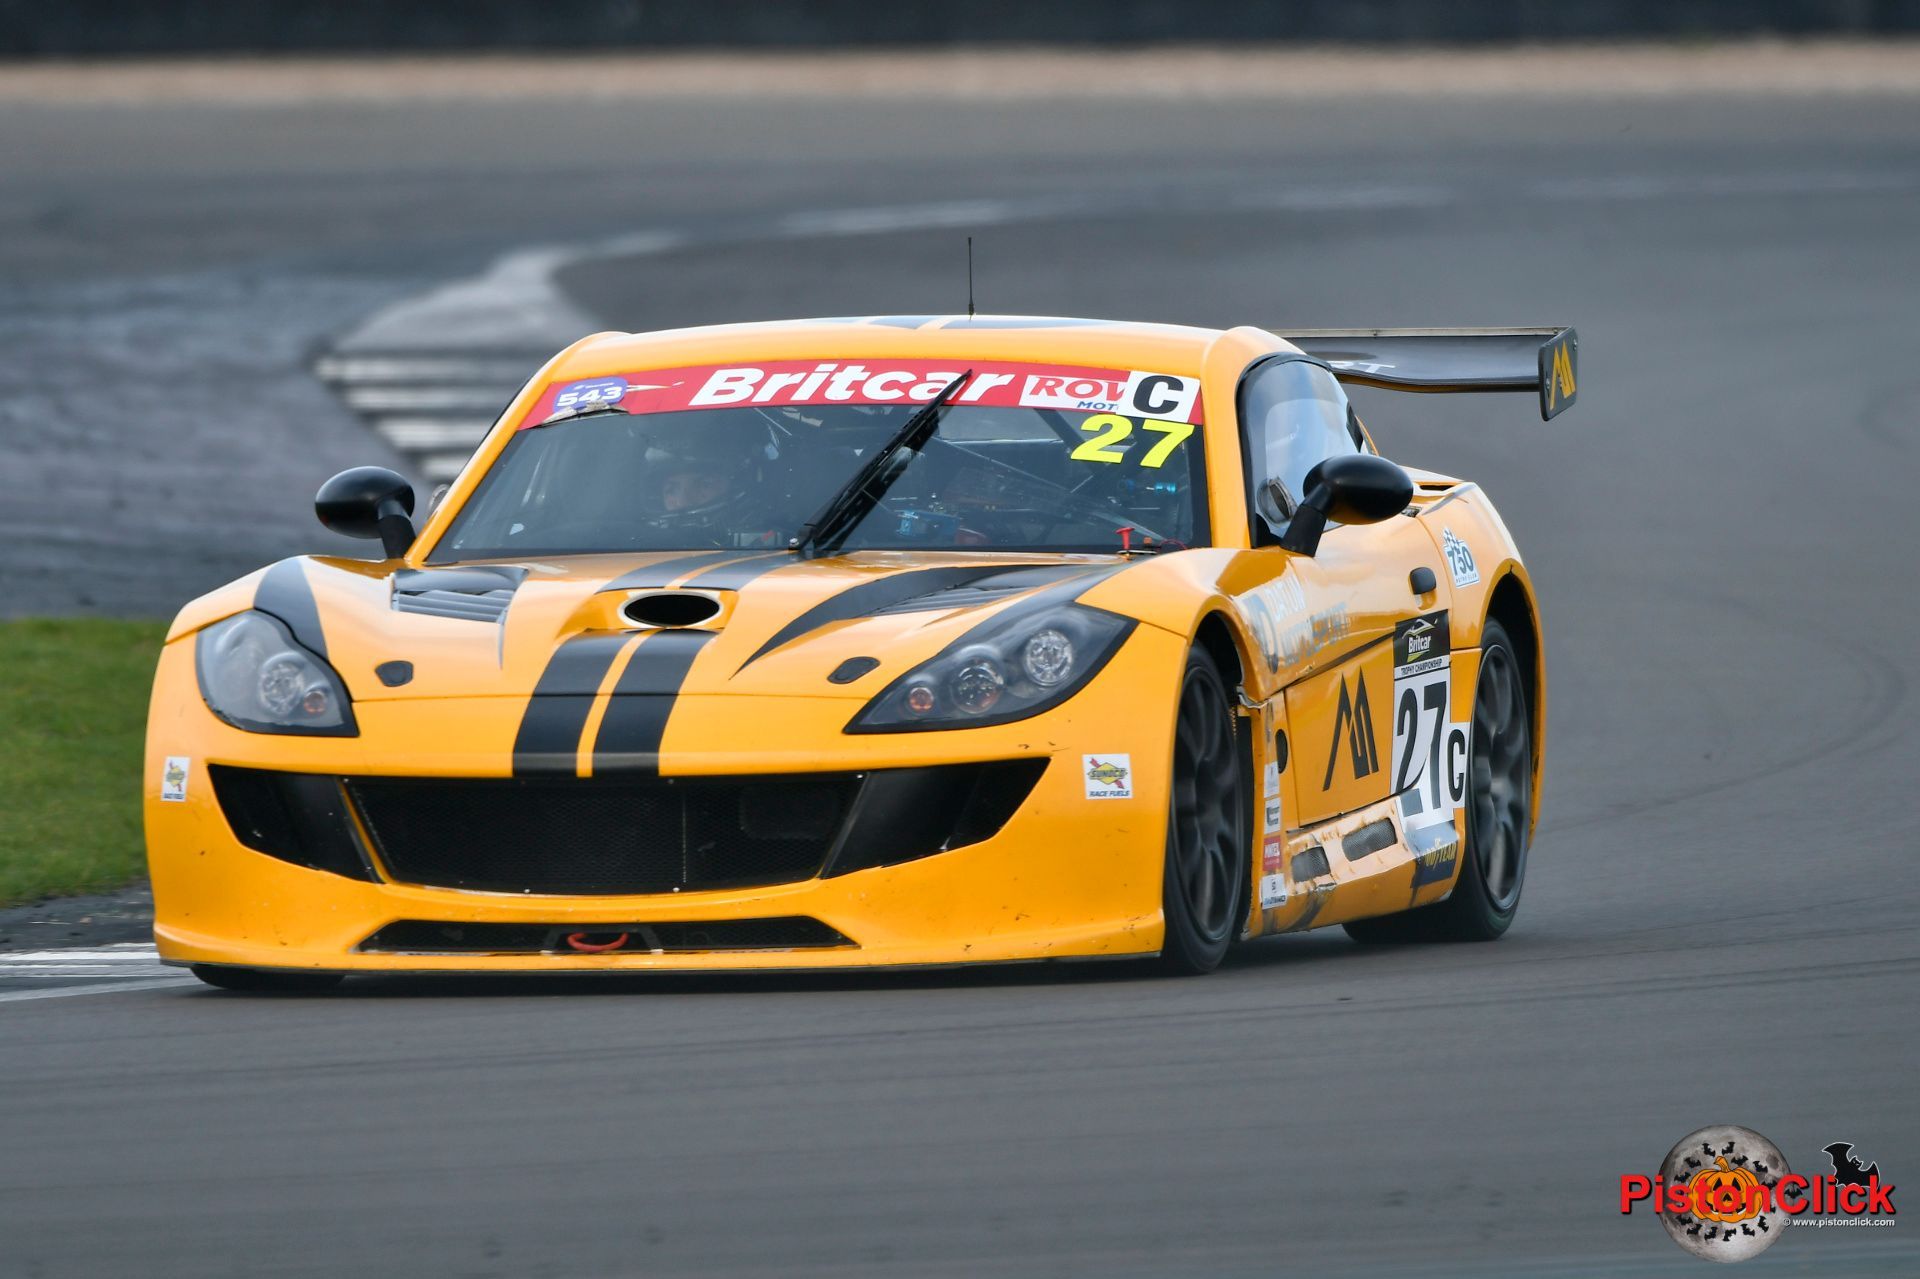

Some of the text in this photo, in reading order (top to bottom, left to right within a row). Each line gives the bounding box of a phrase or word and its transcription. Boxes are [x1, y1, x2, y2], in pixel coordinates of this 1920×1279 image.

[557, 386, 623, 407] 543
[688, 363, 1015, 406] Britcar
[1132, 374, 1184, 415] C
[1077, 401, 1119, 411] MOT
[1070, 413, 1195, 469] 27
[1447, 546, 1474, 576] 750
[1409, 635, 1431, 653] Britcar
[1396, 681, 1466, 818] 27 C
